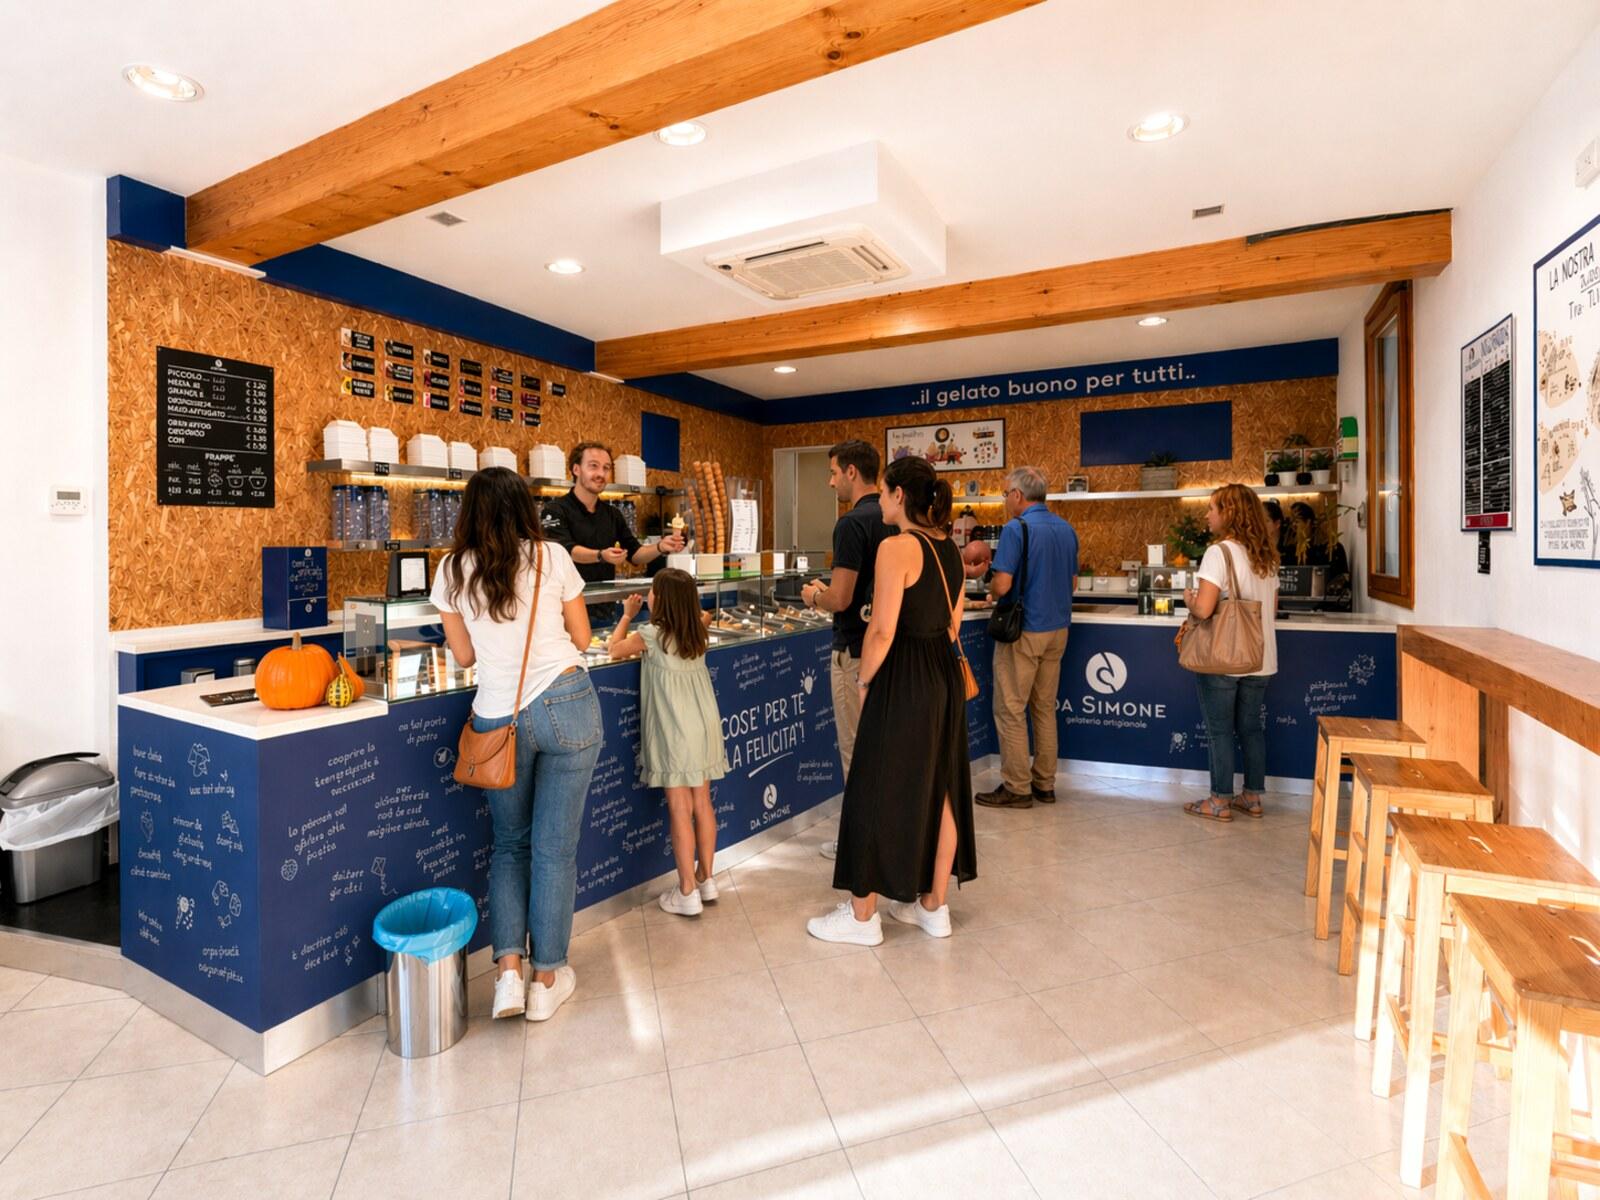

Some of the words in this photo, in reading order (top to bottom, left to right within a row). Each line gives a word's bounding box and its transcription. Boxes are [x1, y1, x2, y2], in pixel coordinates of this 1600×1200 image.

[1549, 267, 1559, 291] LA
[1562, 242, 1595, 282] NOSTRA
[167, 368, 202, 381] PICCOLO
[936, 384, 1000, 407] gelato
[1008, 379, 1077, 396] buono
[1086, 373, 1124, 393] per
[1132, 363, 1196, 384] tutti..
[765, 698, 788, 725] PER
[792, 692, 805, 715] TE
